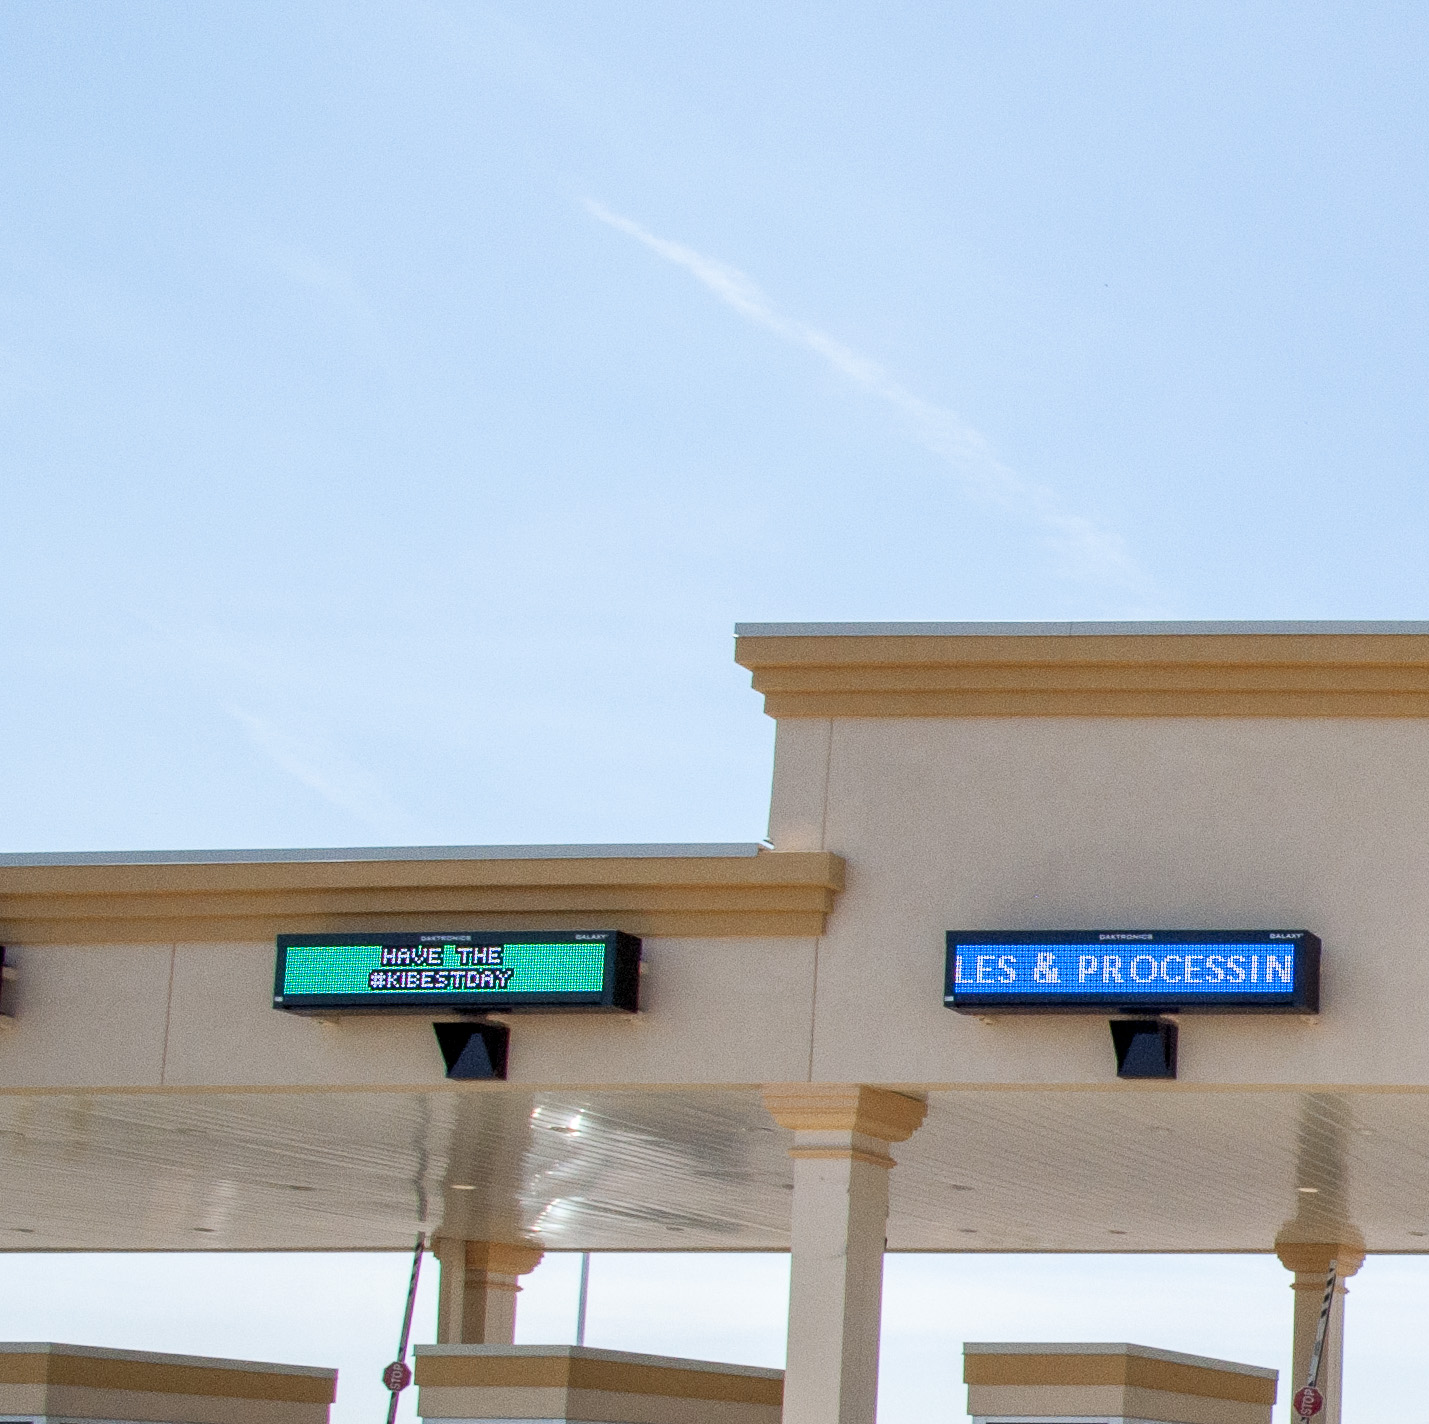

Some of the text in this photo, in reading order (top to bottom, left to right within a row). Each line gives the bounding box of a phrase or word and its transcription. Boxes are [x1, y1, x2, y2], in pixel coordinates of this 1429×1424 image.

[381, 946, 502, 965] HAVE THE
[1034, 952, 1061, 984] &
[1078, 954, 1292, 983] PROCESSIN
[369, 970, 512, 988] #KIBESTDAY
[390, 1362, 405, 1392] STOP
[1300, 1389, 1314, 1415] STOP
